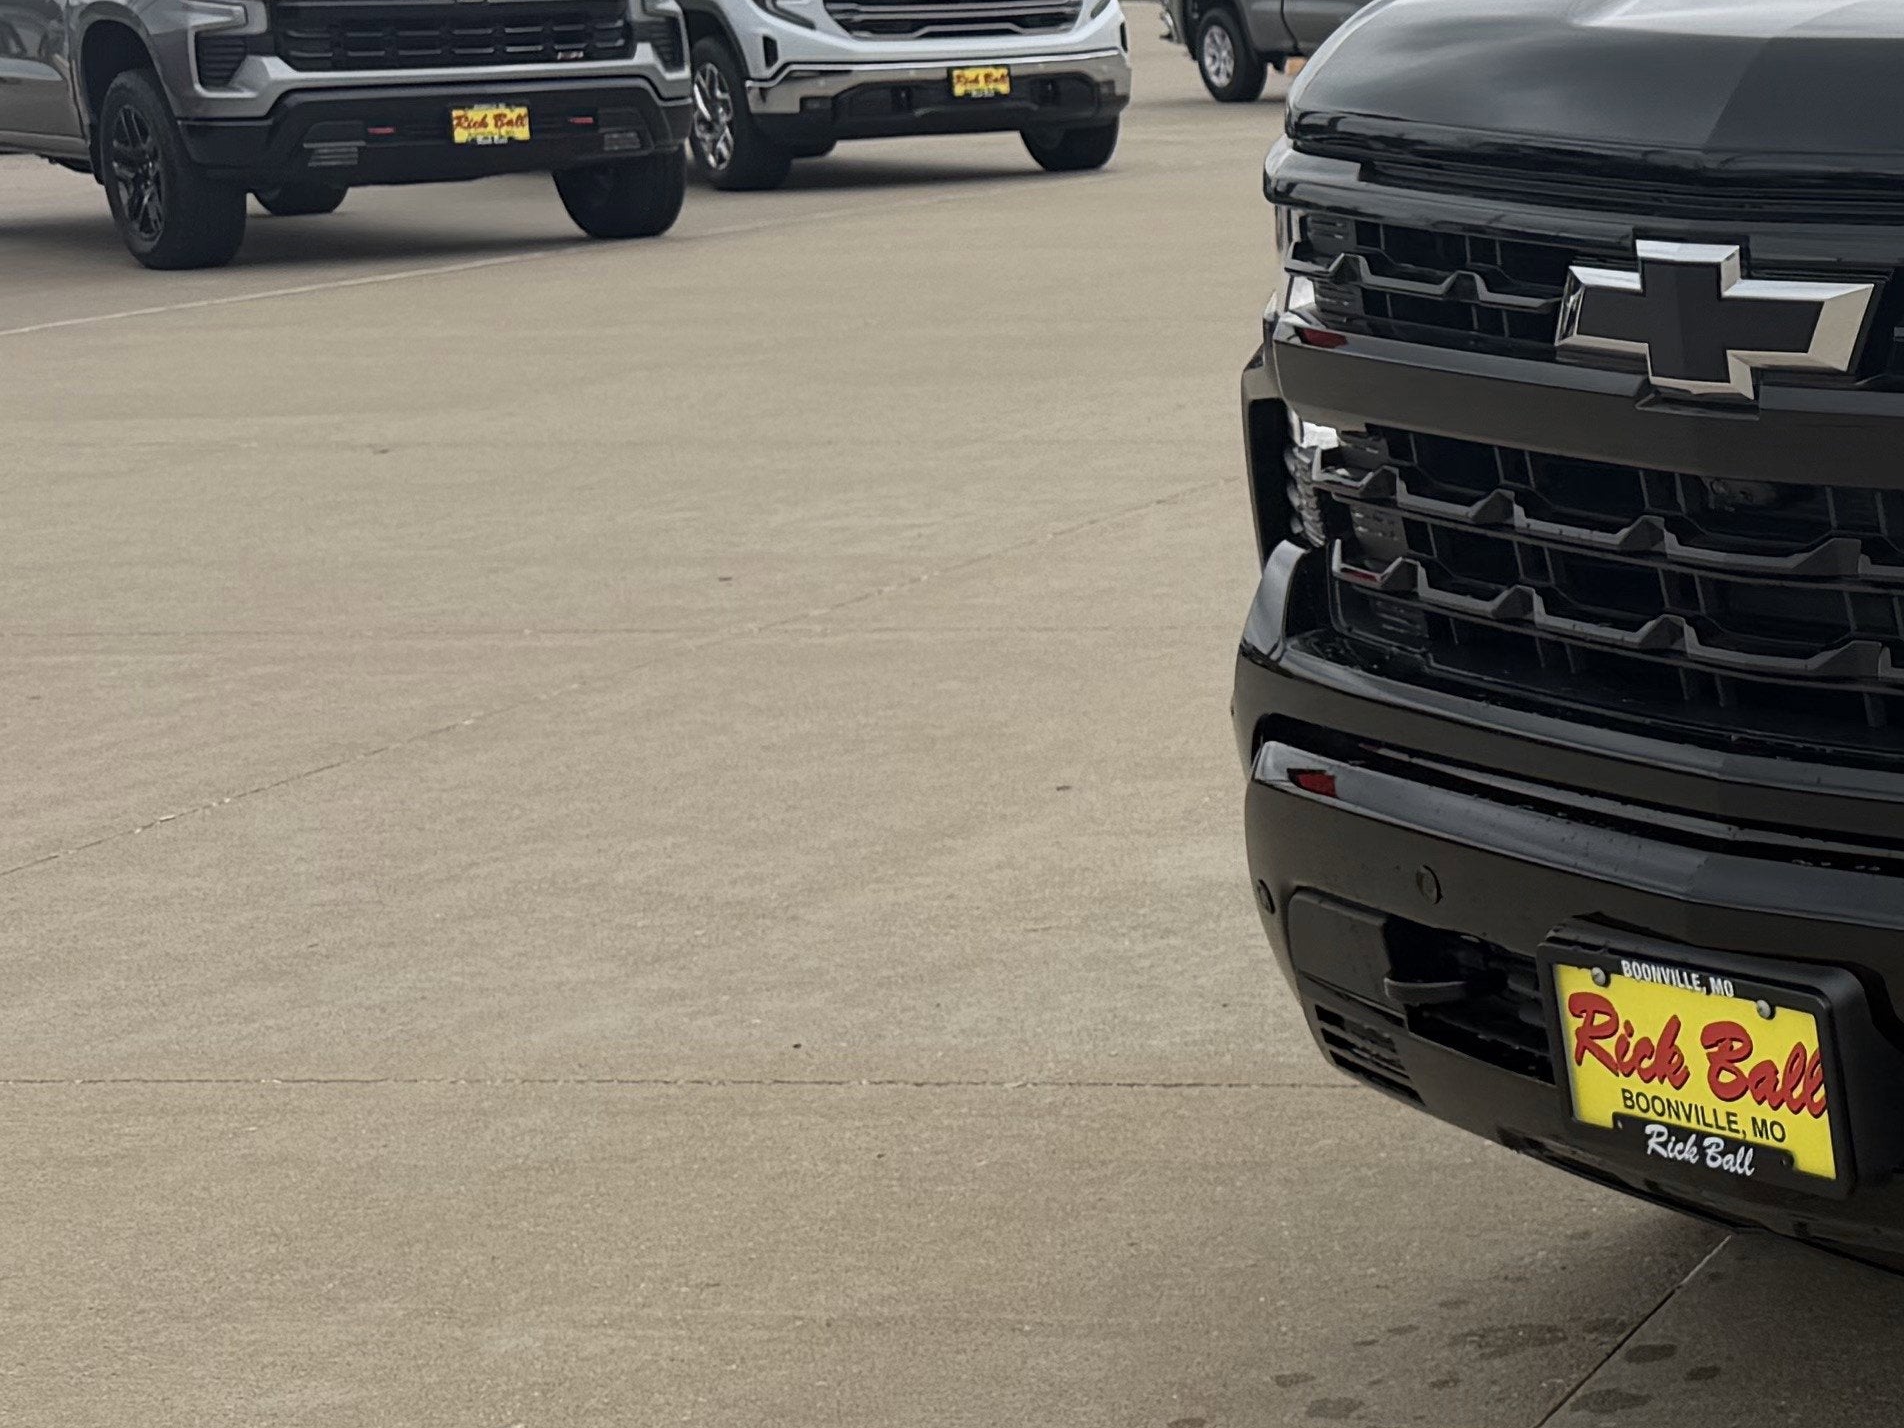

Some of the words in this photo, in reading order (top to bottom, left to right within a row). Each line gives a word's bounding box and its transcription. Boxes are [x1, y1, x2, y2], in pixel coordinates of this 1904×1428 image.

[1620, 959, 1708, 995] BOONVILLE,
[1709, 975, 1735, 998] MO
[1568, 991, 1690, 1091] Rick
[1700, 1020, 1828, 1119] Ball
[1620, 1088, 1748, 1142] BOONVILLE,
[1752, 1115, 1787, 1143] MO
[1644, 1124, 1700, 1165] Rick
[1702, 1137, 1755, 1177] Ball
